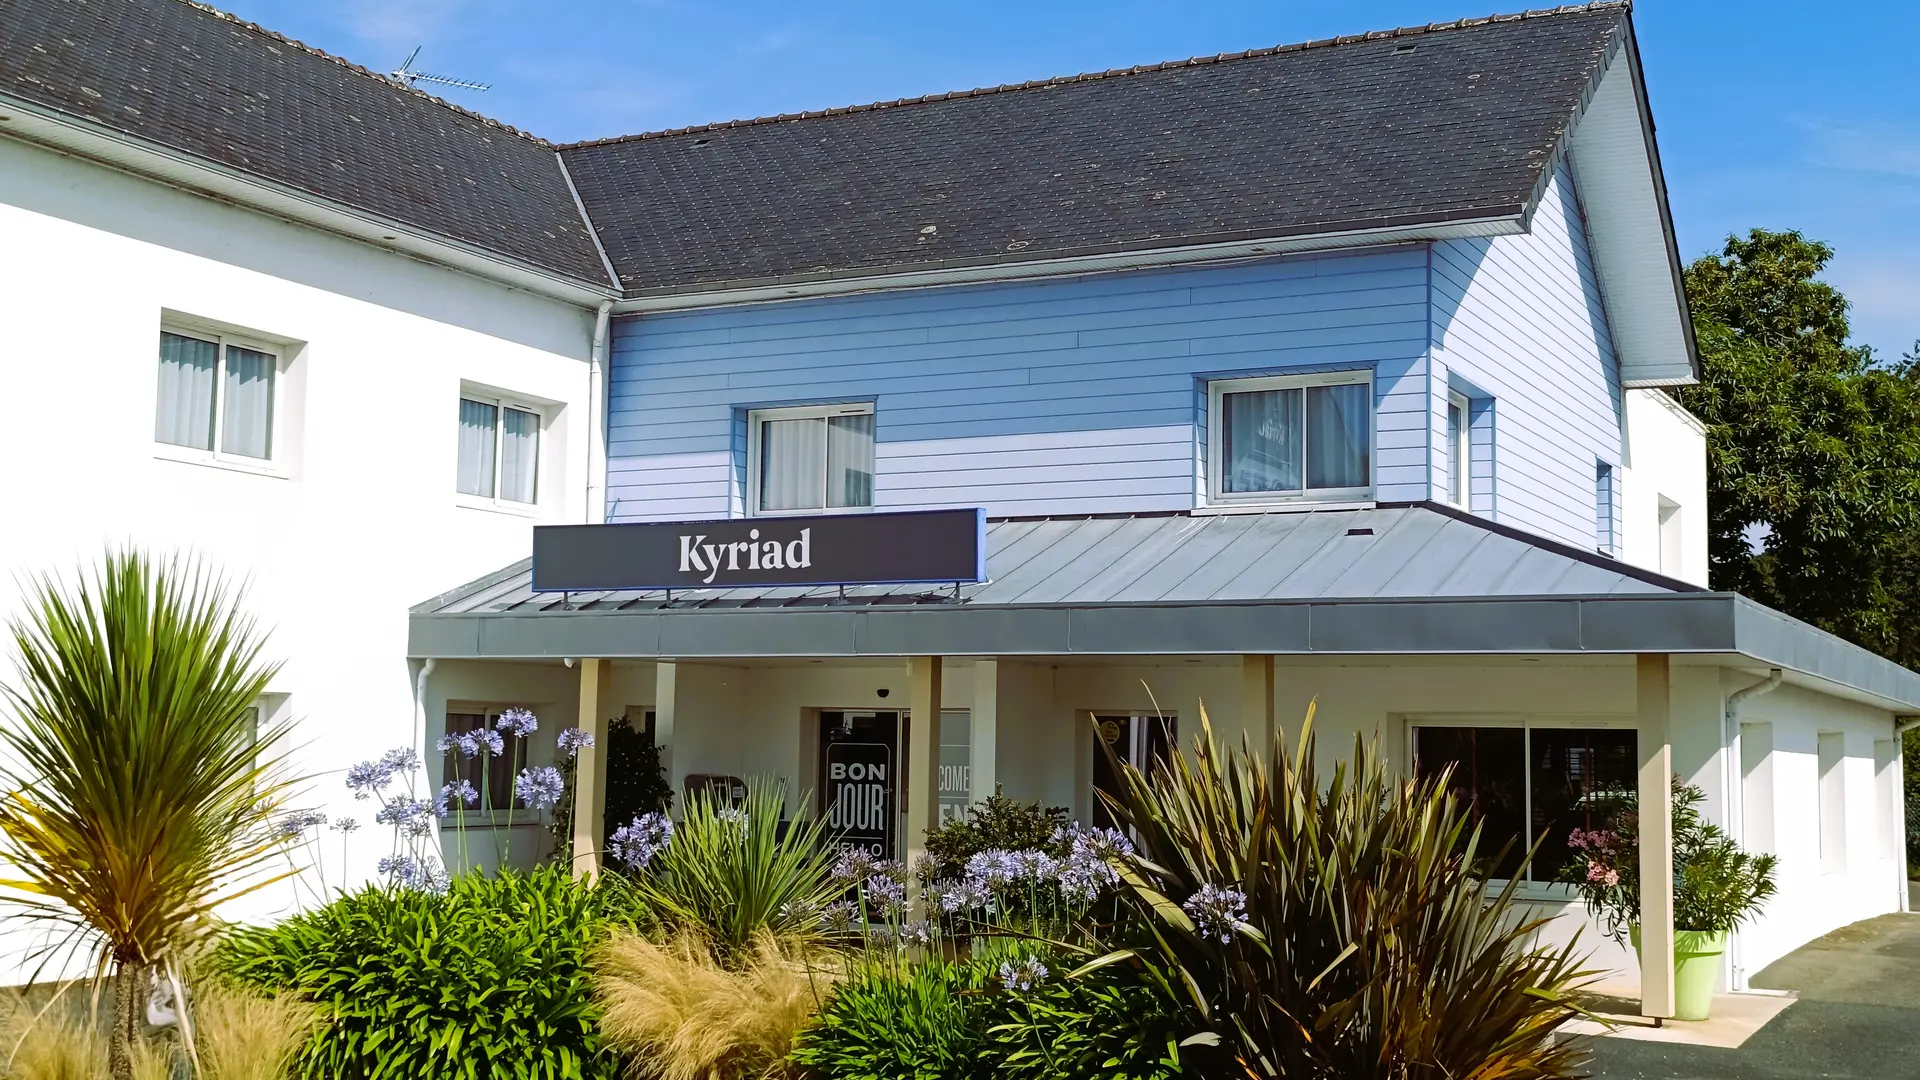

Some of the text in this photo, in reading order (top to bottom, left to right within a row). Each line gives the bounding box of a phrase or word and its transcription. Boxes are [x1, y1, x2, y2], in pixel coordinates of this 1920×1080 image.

[679, 528, 811, 583] Kyriad
[831, 763, 885, 780] BON
[939, 765, 969, 791] COME
[830, 783, 883, 830] JOUR
